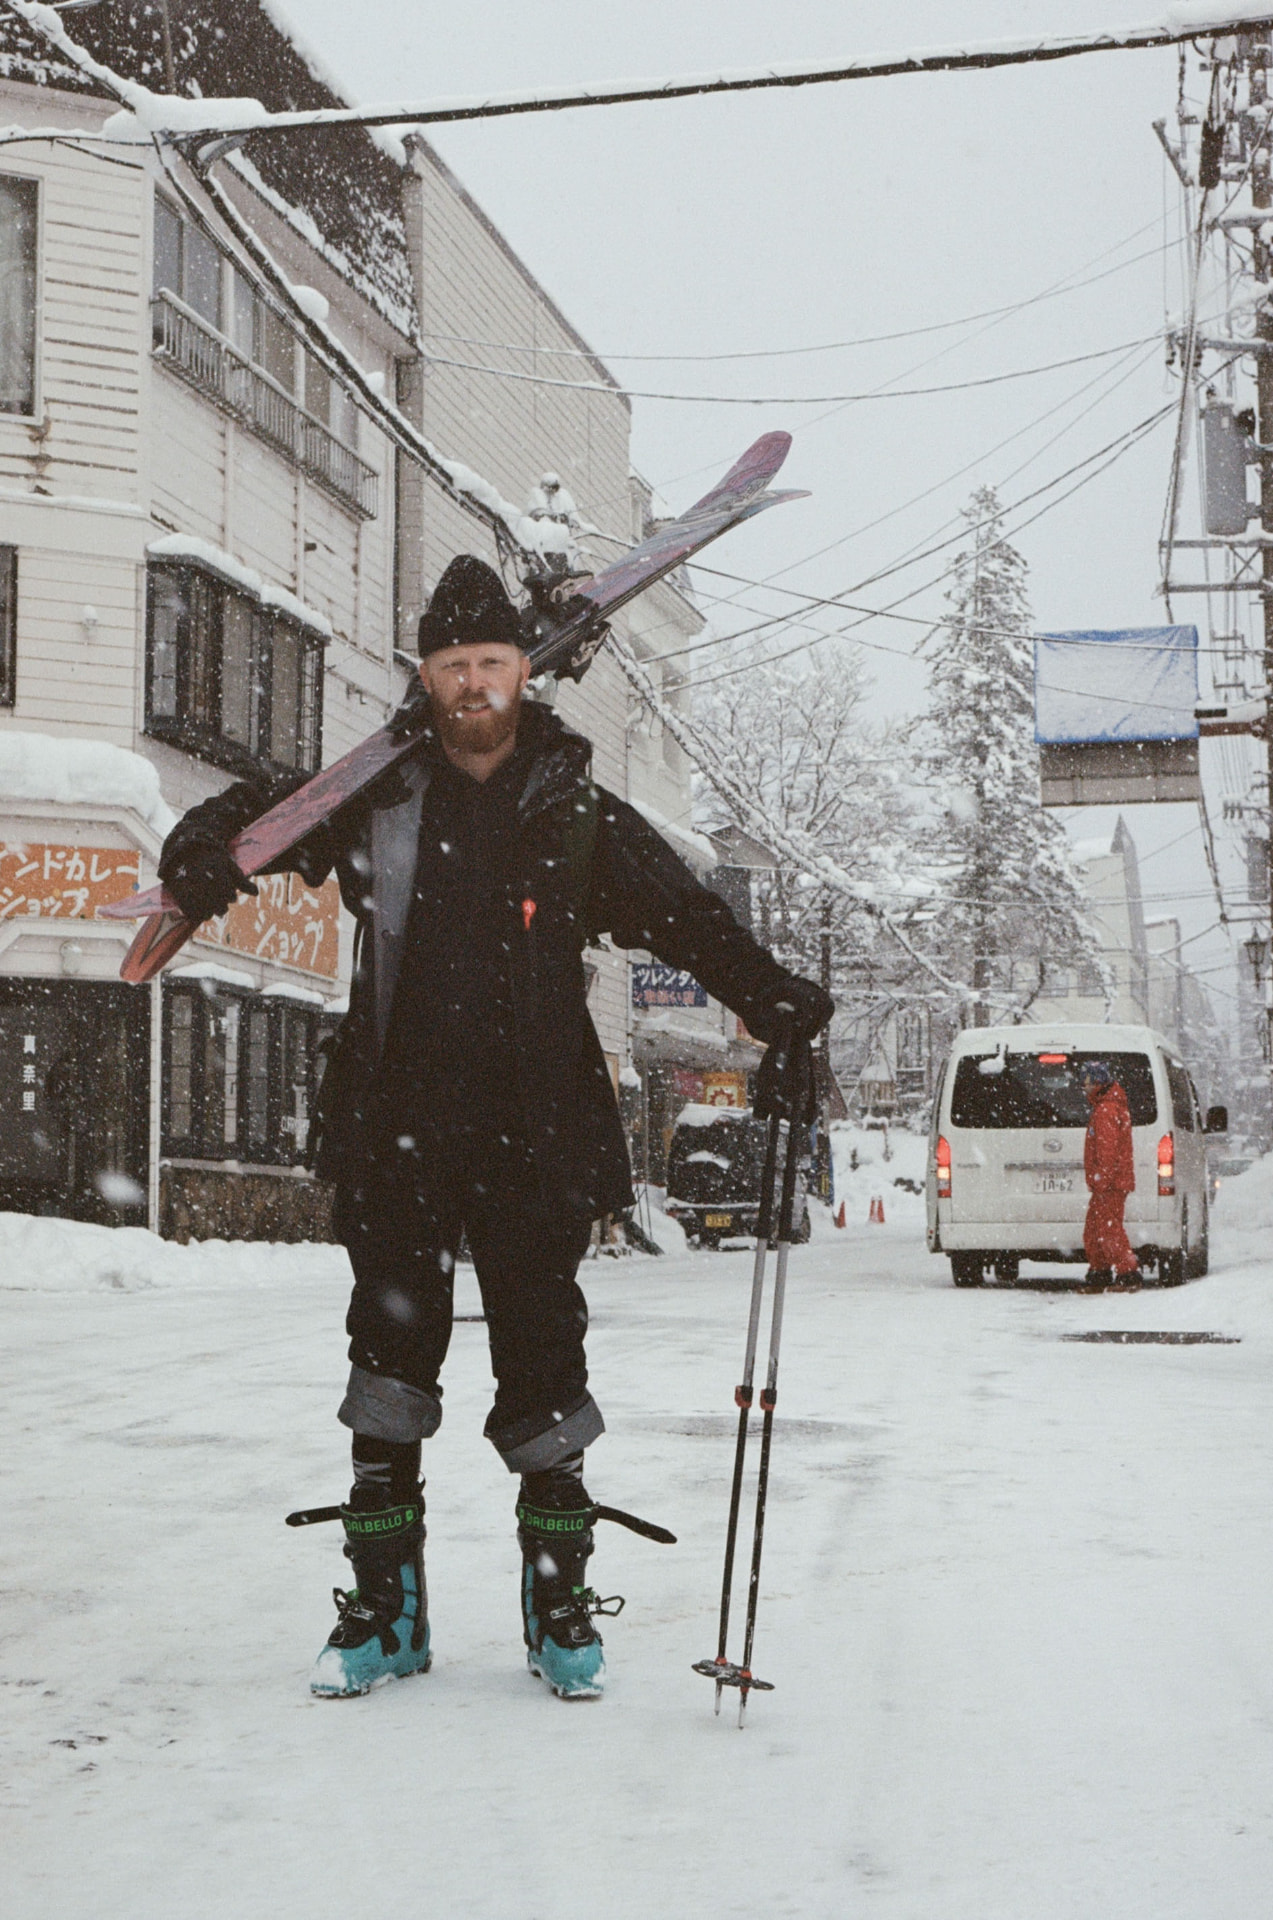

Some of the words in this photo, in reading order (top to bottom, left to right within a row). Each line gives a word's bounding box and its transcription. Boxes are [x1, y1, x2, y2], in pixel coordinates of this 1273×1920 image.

[0, 850, 138, 882] ンドカレー
[254, 909, 324, 967] ショップ
[344, 1515, 402, 1533] DALBELLO
[526, 1513, 584, 1532] DALBELLO
